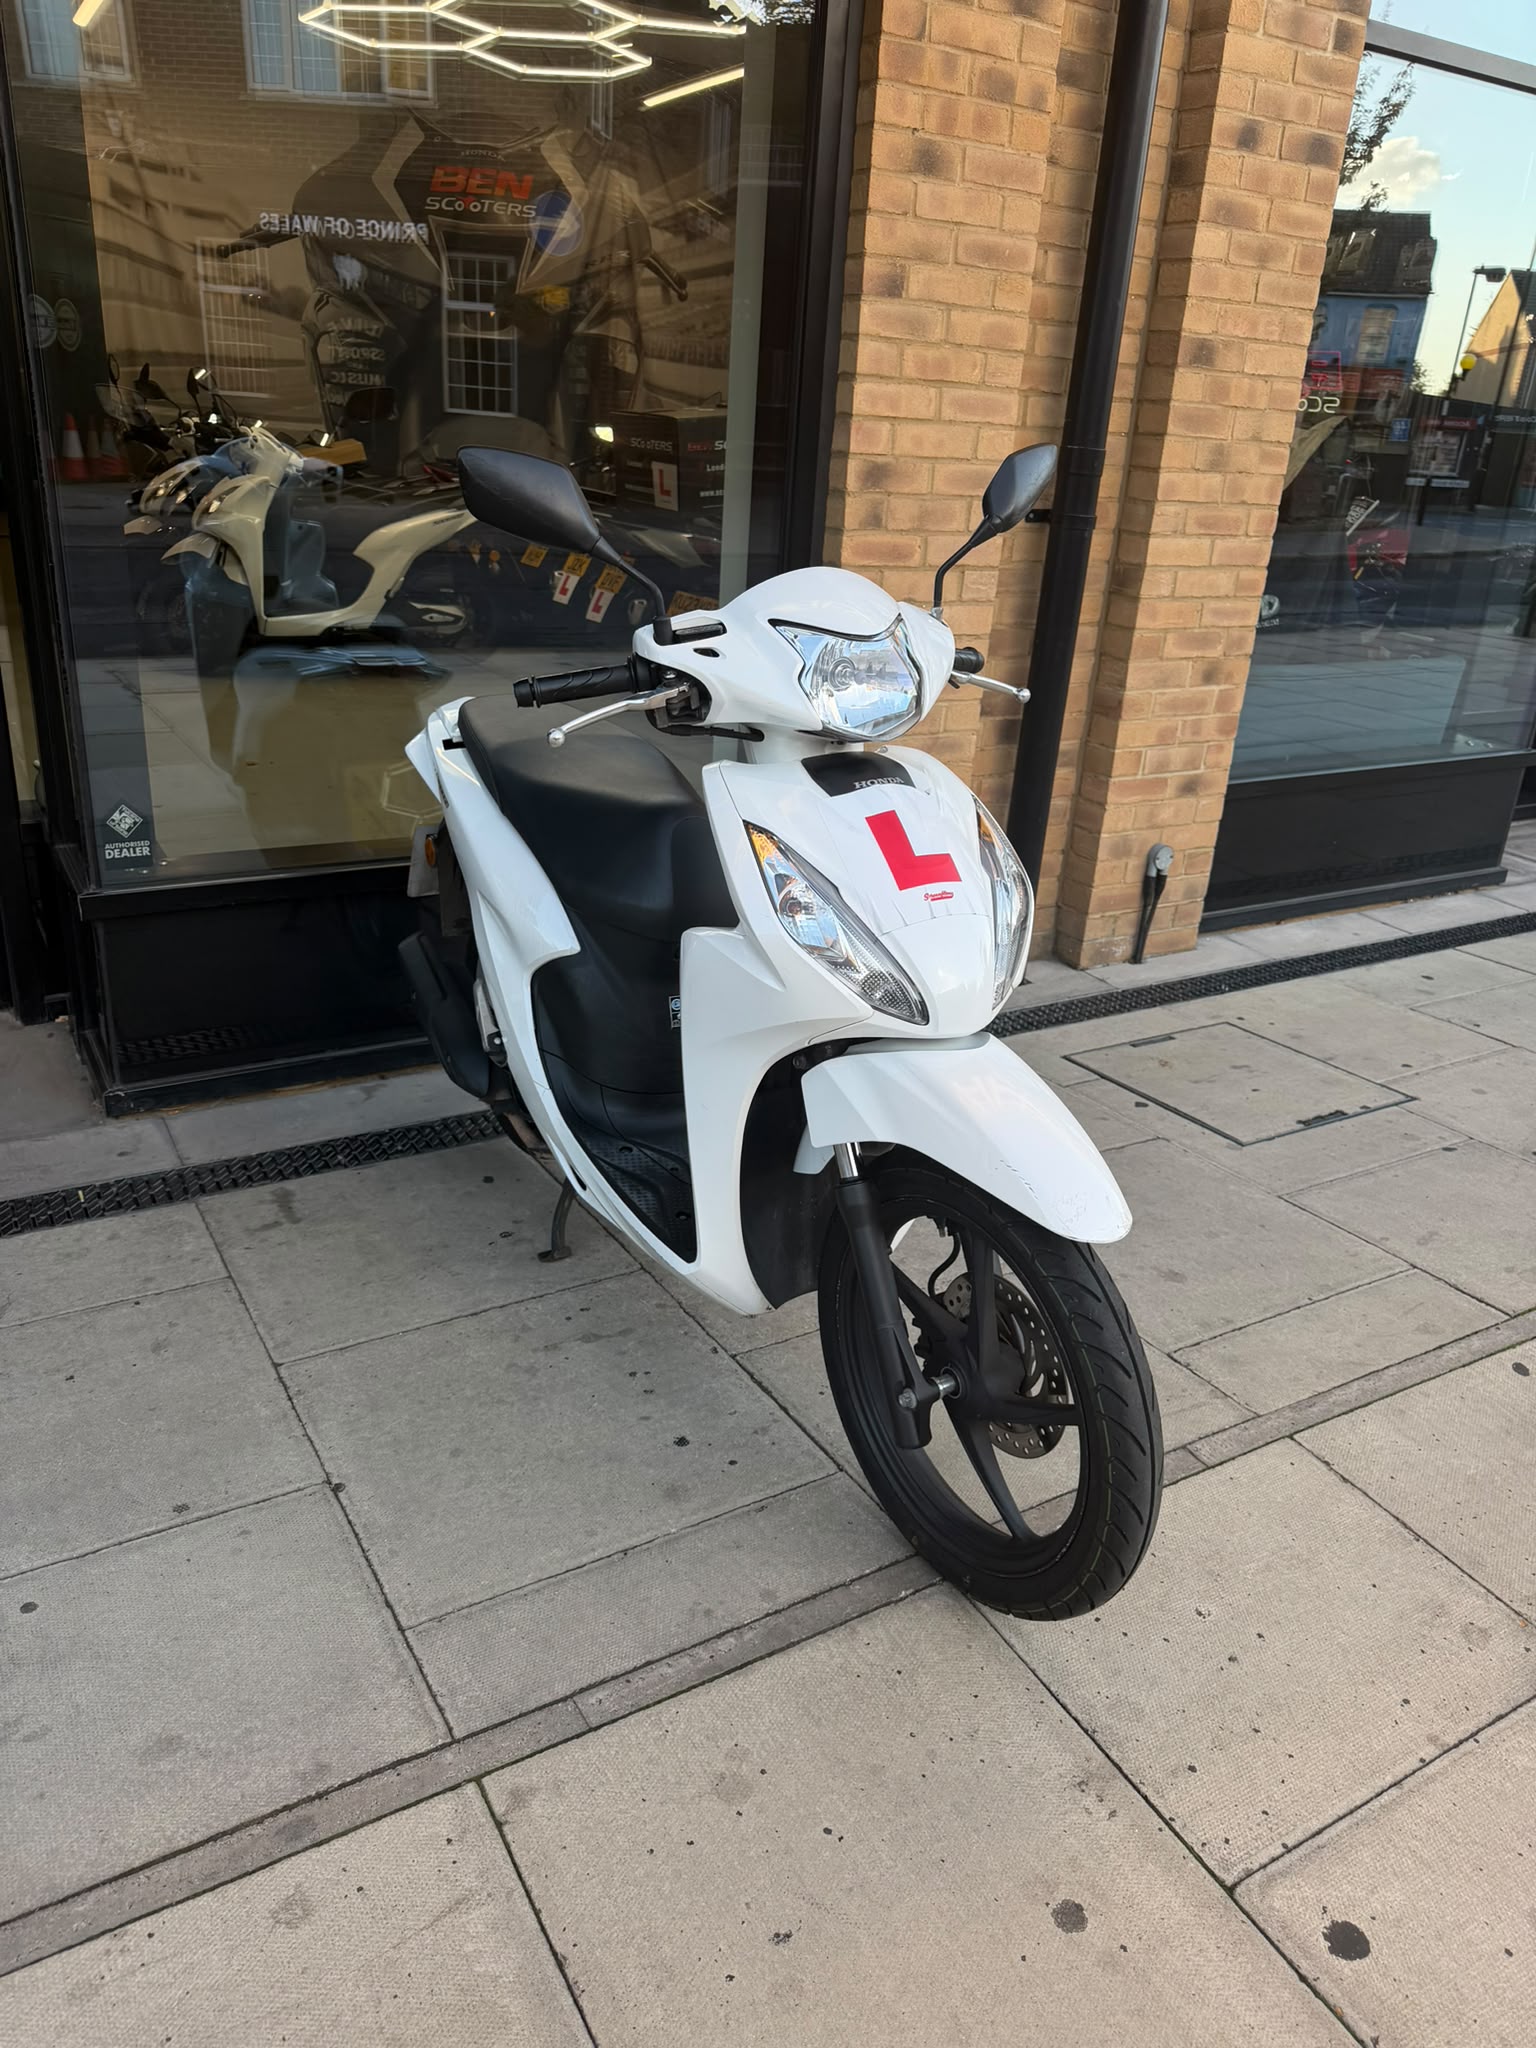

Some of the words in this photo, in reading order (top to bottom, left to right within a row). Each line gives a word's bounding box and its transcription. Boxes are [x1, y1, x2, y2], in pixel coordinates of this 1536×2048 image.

[430, 166, 534, 199] BEN
[658, 468, 672, 497] L
[559, 575, 569, 596] L
[592, 591, 602, 613] L
[853, 776, 905, 789] HONDA
[104, 840, 151, 850] AUTHORISED
[104, 846, 151, 859] DEALER
[865, 809, 962, 891] L
